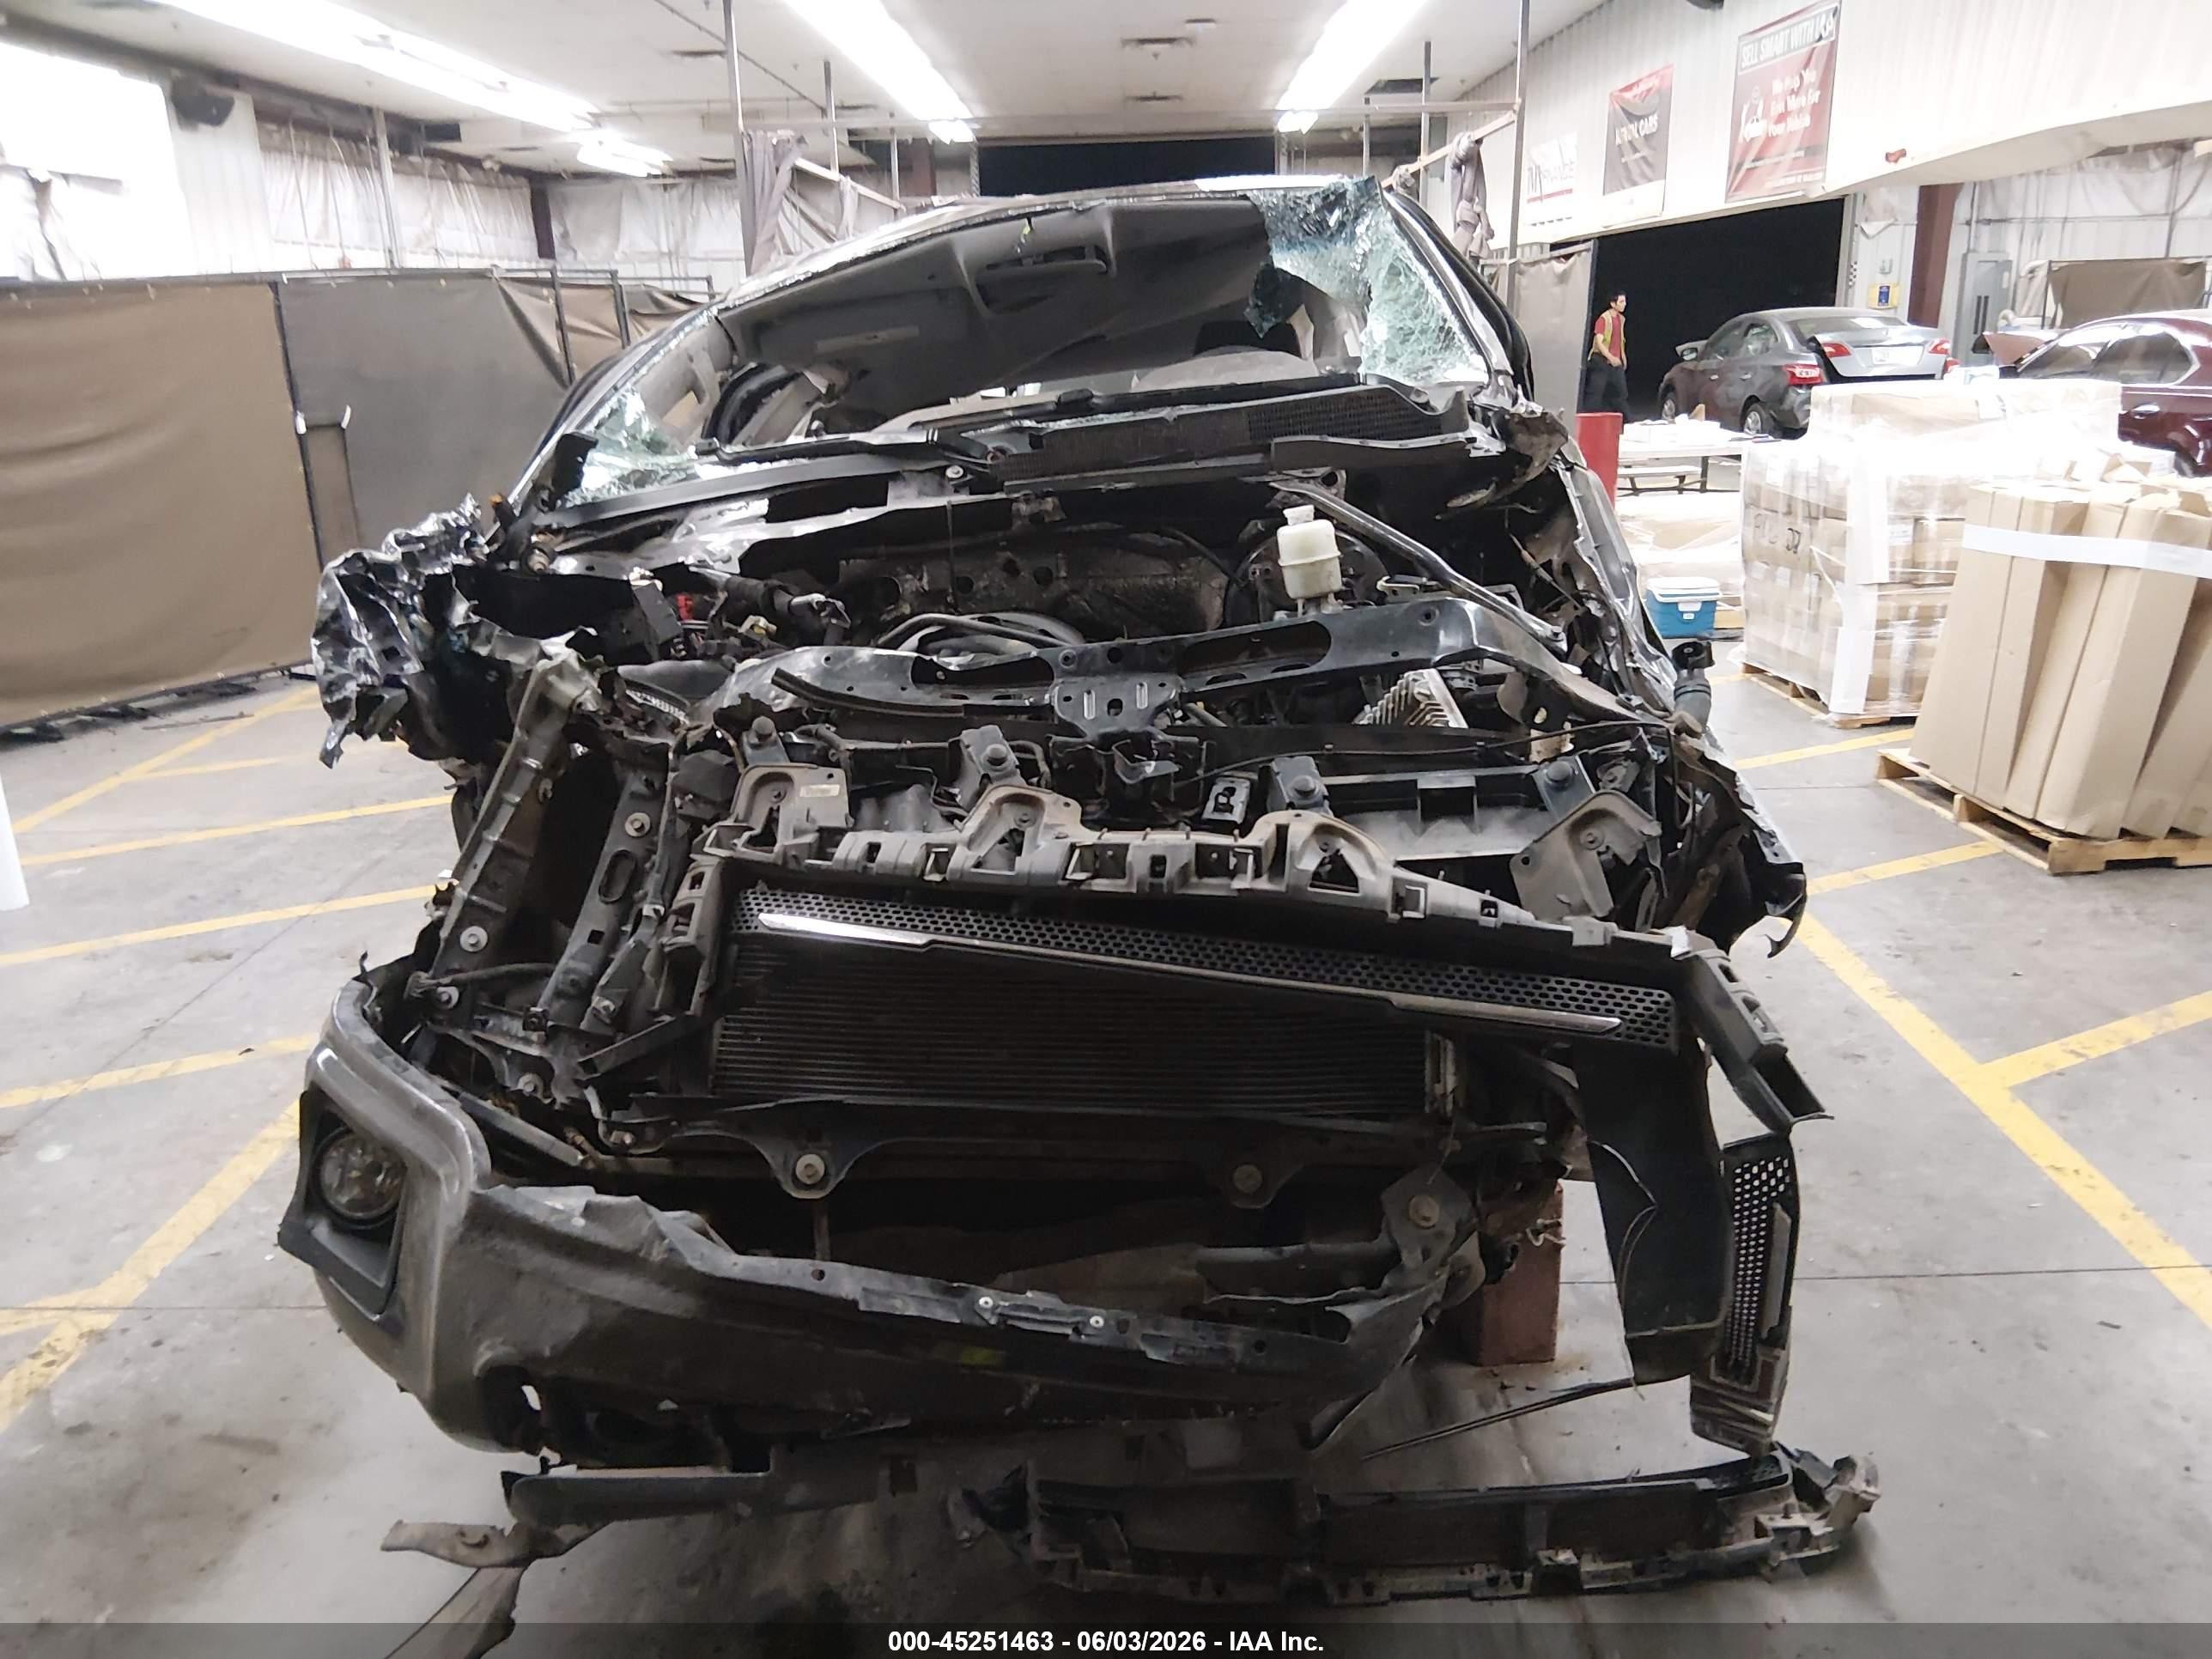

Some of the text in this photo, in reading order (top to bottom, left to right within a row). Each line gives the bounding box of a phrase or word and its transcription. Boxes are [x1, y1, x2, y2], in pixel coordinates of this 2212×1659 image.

[1741, 41, 1759, 69] SELL
[1759, 28, 1790, 61] SMART
[1790, 20, 1814, 49] WITH
